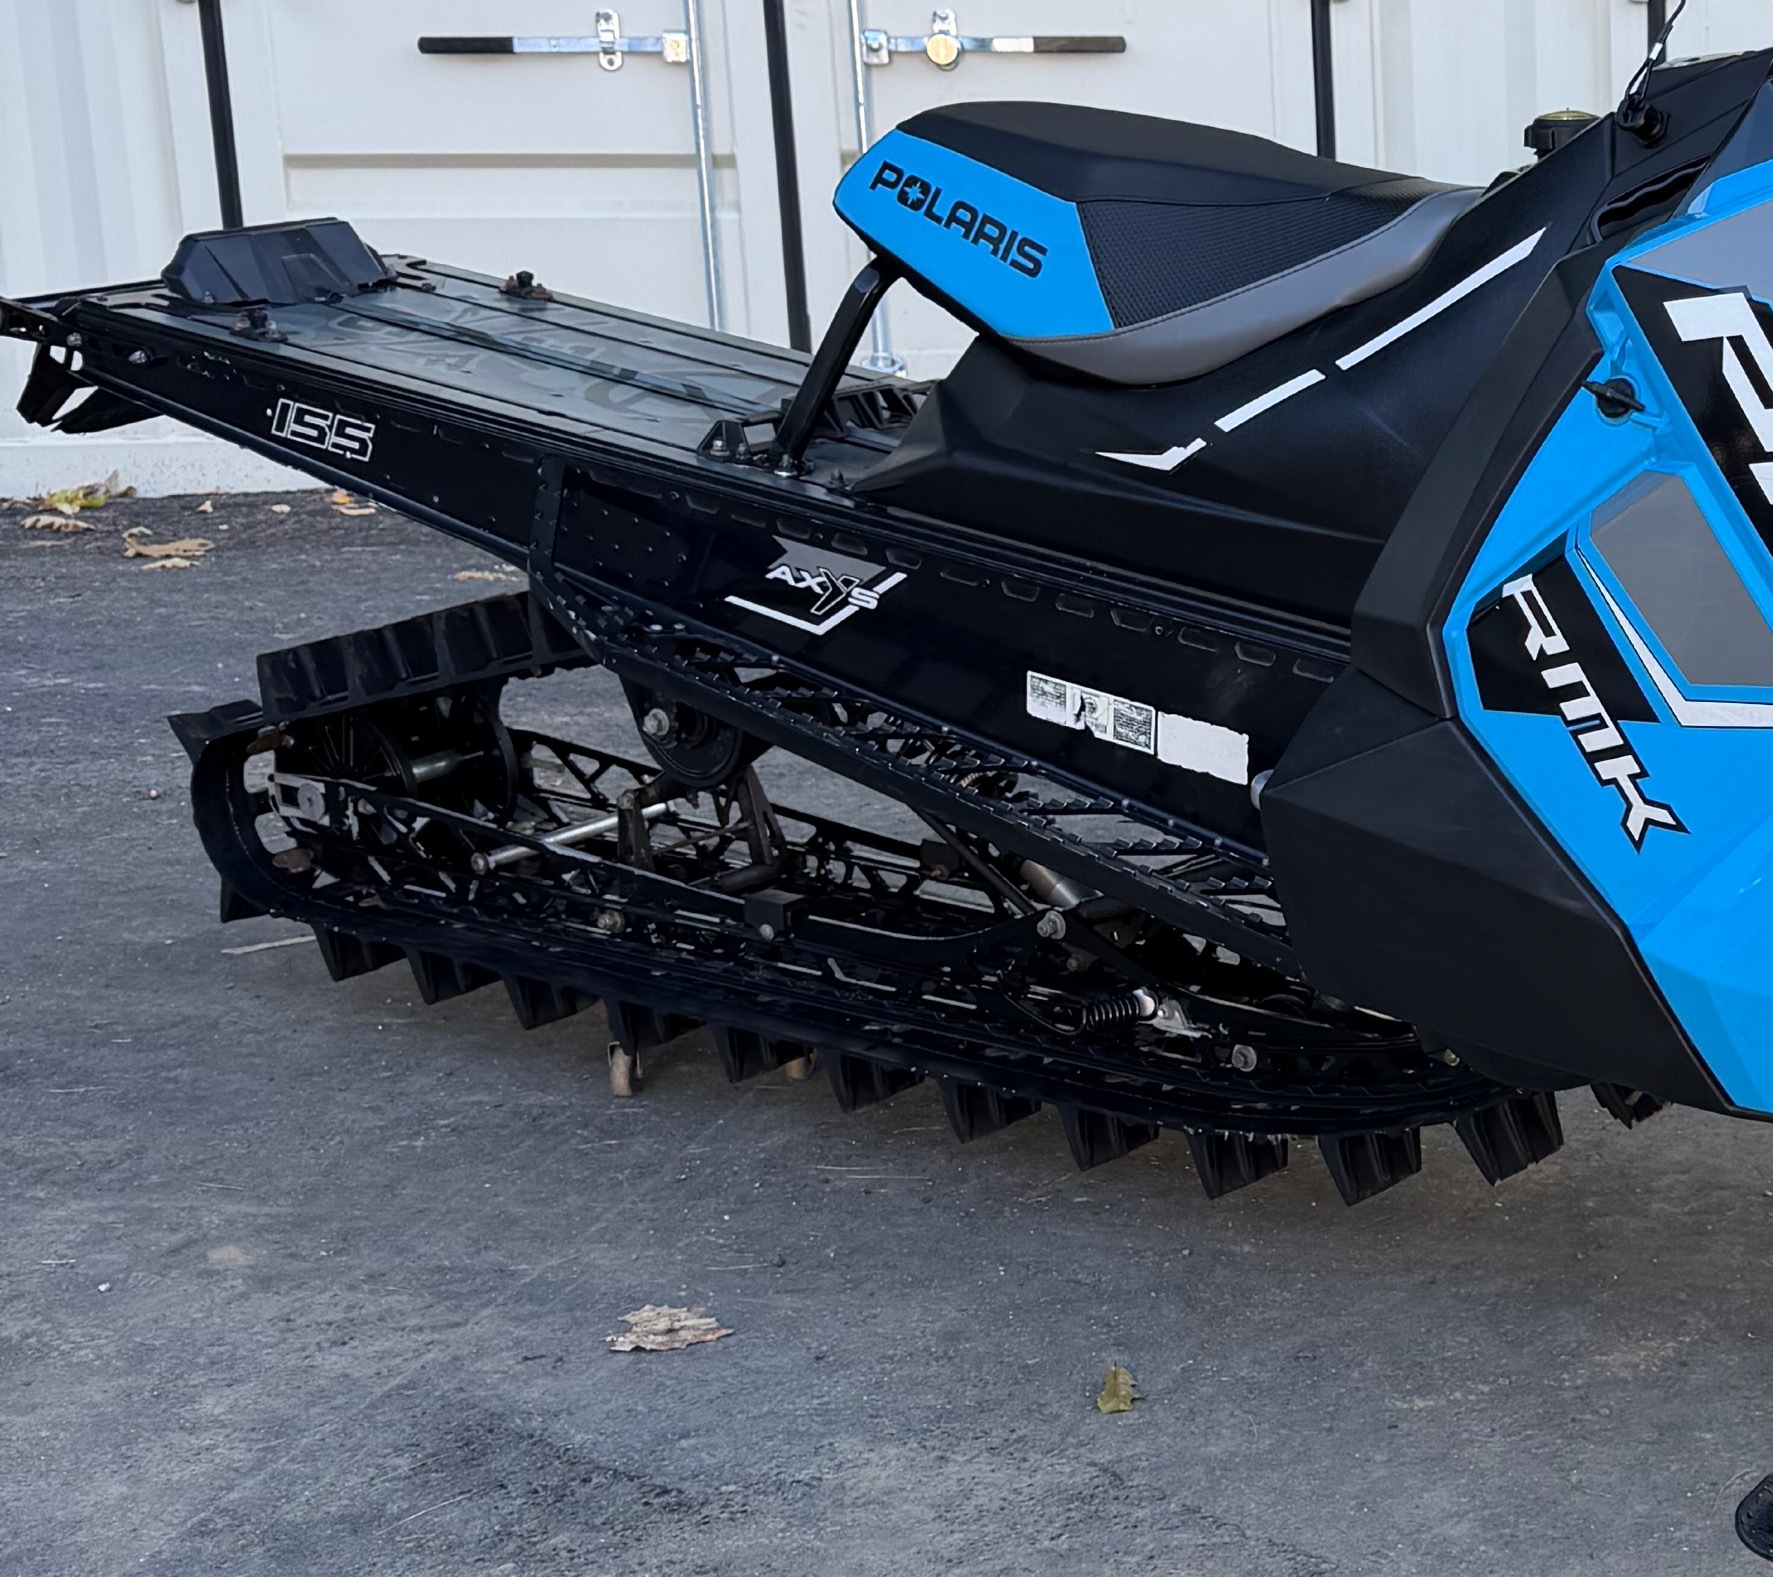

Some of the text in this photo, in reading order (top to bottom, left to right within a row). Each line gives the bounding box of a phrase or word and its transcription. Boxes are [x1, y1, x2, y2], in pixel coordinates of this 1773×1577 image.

[869, 161, 1048, 279] POLARIS
[272, 398, 376, 462] 155
[765, 565, 880, 615] AXYS
[1502, 574, 1677, 842] RMK
